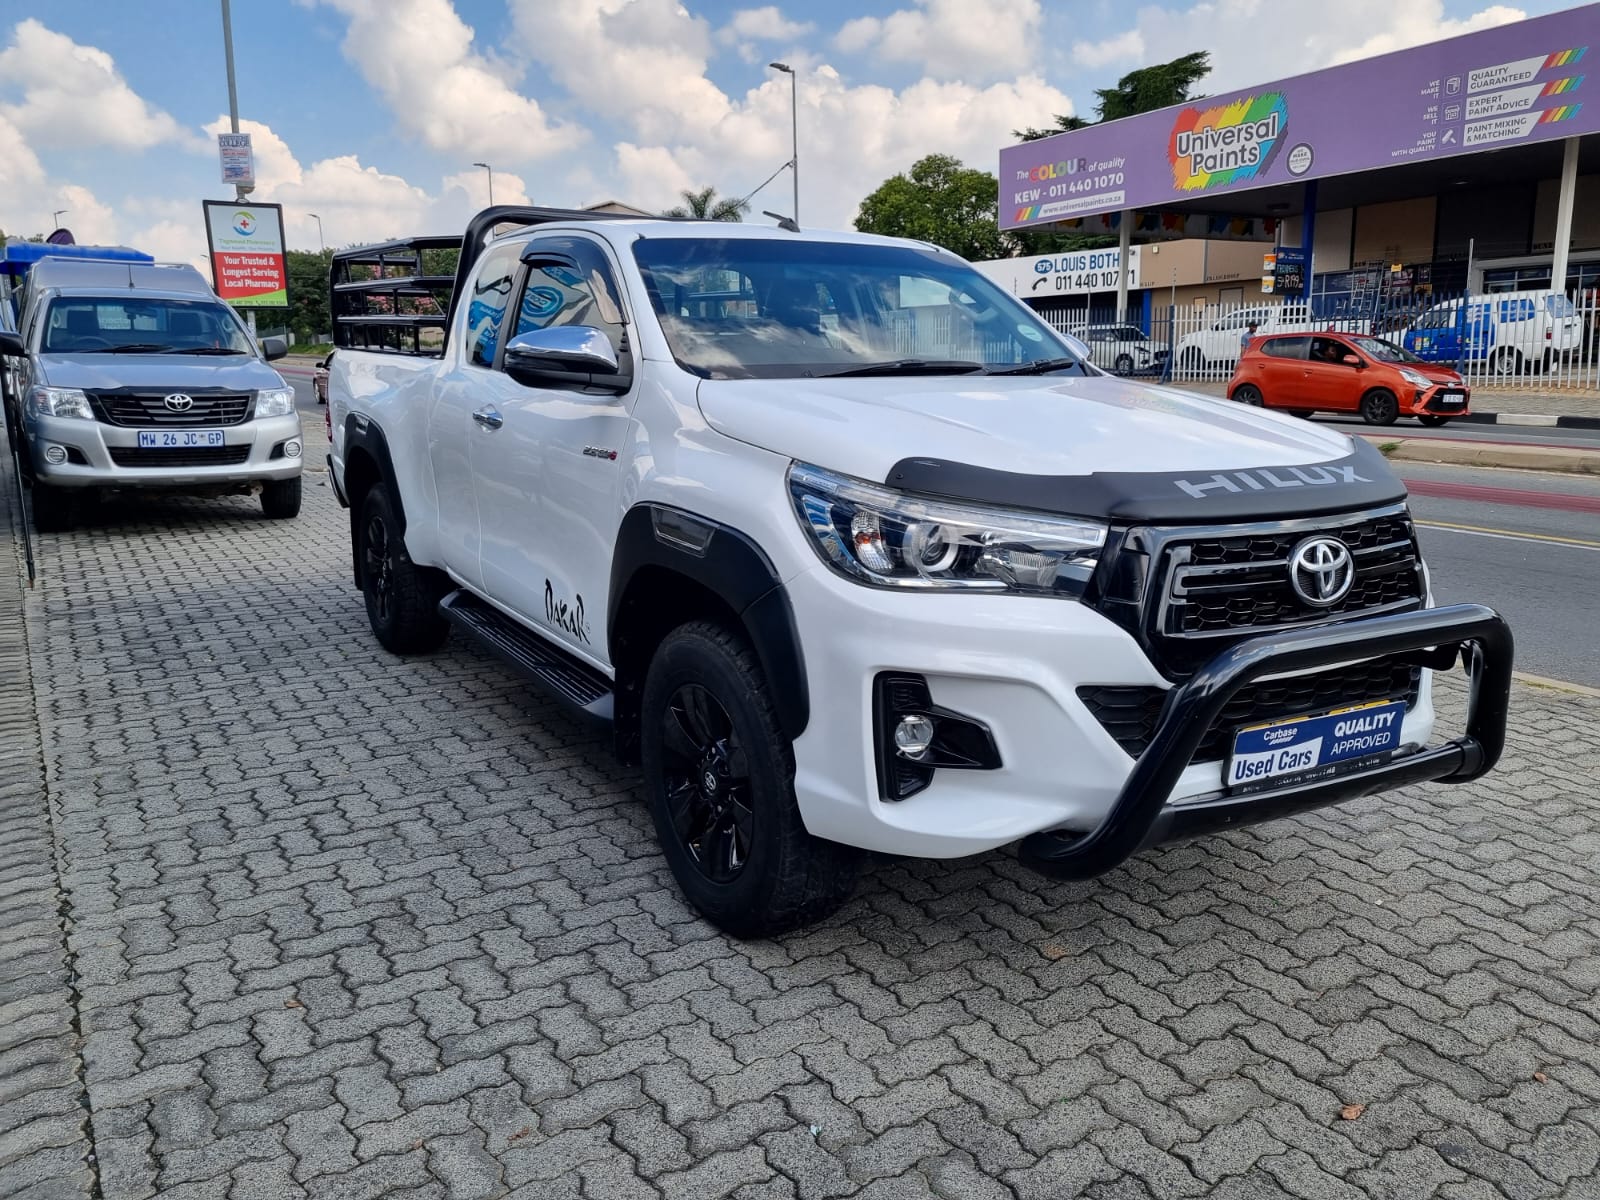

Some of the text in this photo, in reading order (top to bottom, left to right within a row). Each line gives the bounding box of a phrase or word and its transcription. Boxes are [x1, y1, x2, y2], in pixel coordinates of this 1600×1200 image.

[1470, 71, 1531, 89] GUARANTEED
[1471, 67, 1509, 82] QUALITY
[1421, 87, 1440, 95] MAKE
[1429, 80, 1440, 88] WE
[1468, 98, 1530, 116] PAINT ADVICE
[1469, 95, 1503, 108] EXPERT
[1178, 113, 1278, 153] Universal
[1467, 117, 1527, 134] PAINT MIXING
[1417, 138, 1436, 146] PAINT
[1473, 128, 1520, 141] MATCHING
[1391, 144, 1436, 157] WITH QUALITY
[1192, 144, 1259, 175] Paints
[1016, 157, 1125, 183] The COLOUR of quality
[1014, 189, 1041, 205] KEW
[1049, 183, 1067, 197] 011
[1069, 178, 1092, 193] 440
[1095, 172, 1124, 189] 1070
[1043, 196, 1122, 214] www.universalpaints.co.za
[224, 256, 275, 266] Your Trusted &
[1054, 256, 1086, 273] LOUIS
[1089, 252, 1120, 270] BOTH
[222, 267, 279, 279] Longest Serving
[1056, 275, 1072, 290] 011
[1075, 272, 1098, 288] 440
[224, 279, 279, 290] Local Pharmacy
[141, 432, 221, 446] MW 26 JC GP
[1173, 466, 1376, 499] HILUX
[1334, 711, 1396, 737] QUALITY
[1263, 727, 1298, 741] Carbase
[1331, 731, 1391, 756] APPROVED
[1235, 753, 1275, 780] Used
[1278, 749, 1312, 770] Cars
